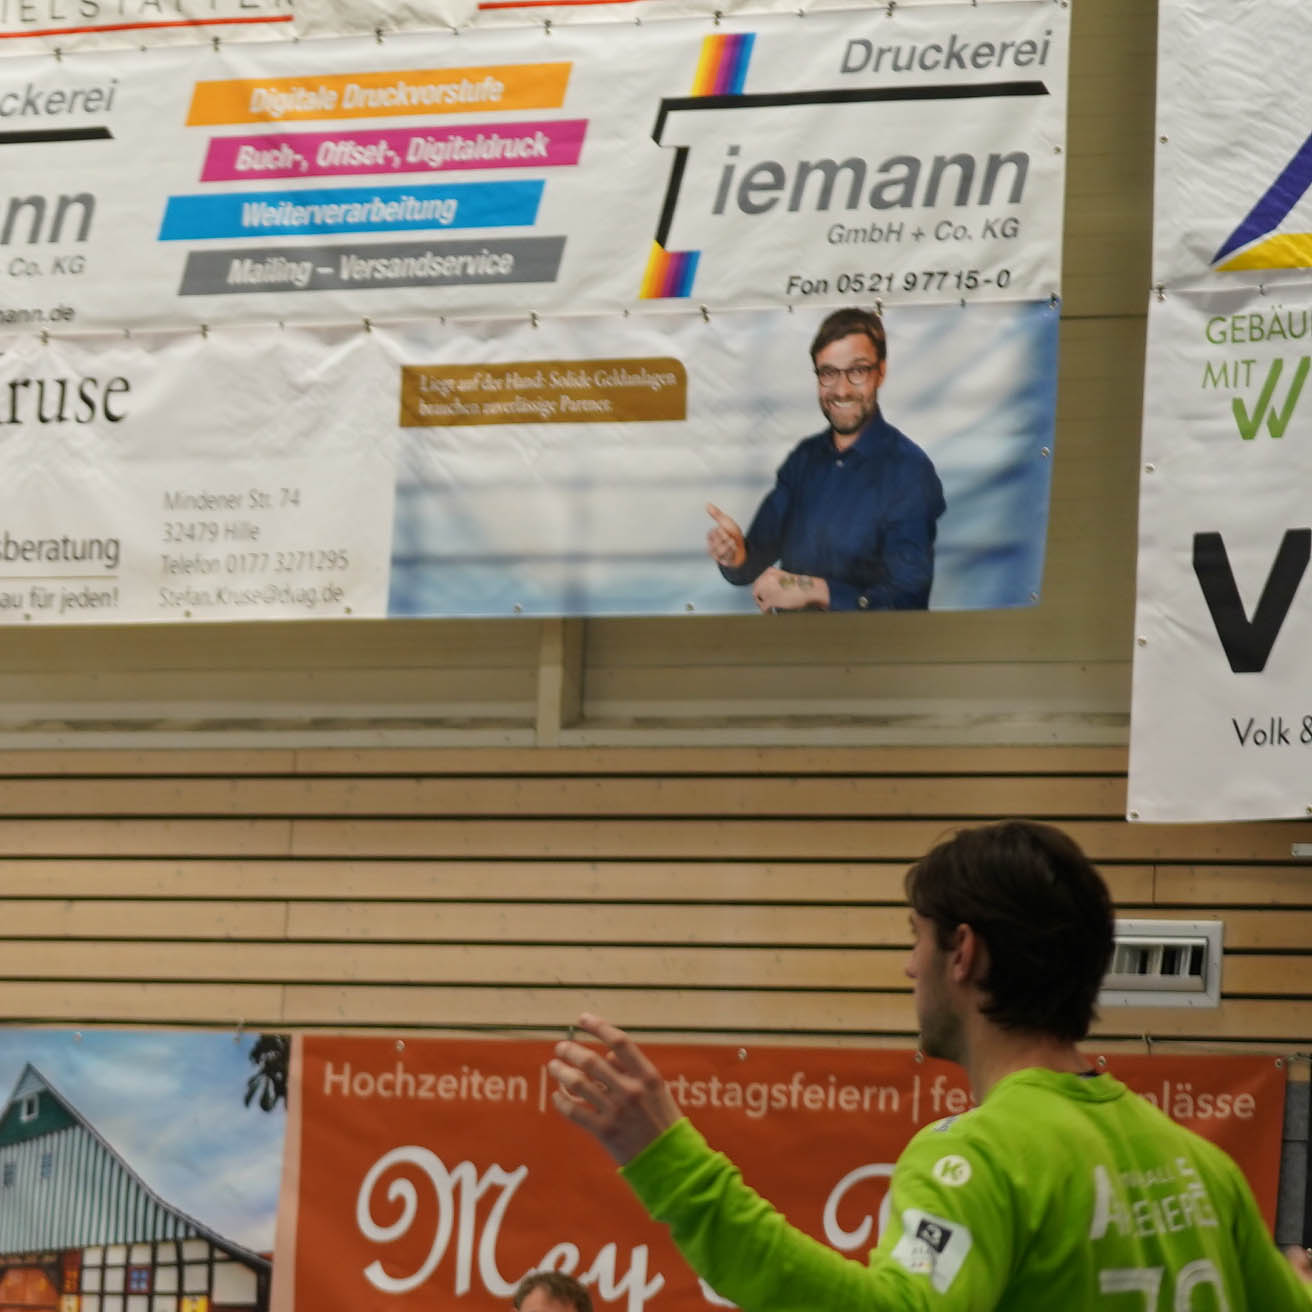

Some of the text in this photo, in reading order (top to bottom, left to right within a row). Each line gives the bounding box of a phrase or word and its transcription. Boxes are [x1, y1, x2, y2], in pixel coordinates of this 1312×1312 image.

[840, 30, 1052, 75] Druckerei
[249, 77, 505, 118] Digitale Druckvorstufe
[405, 132, 550, 167] Digitaldruck
[240, 197, 459, 228] Weiterverarbeitung
[826, 222, 905, 246] GmbH
[934, 221, 973, 243] Co.
[982, 218, 1021, 241] KG
[52, 255, 87, 275] KG
[227, 250, 515, 288] Mailing Versandservice
[786, 276, 828, 296] Fon
[836, 272, 894, 294] 0521
[1206, 304, 1312, 344] GEBÄU
[1202, 360, 1256, 389] MIT
[27, 585, 55, 609] für
[59, 584, 120, 614] jeden!
[1232, 716, 1291, 747] Volk
[323, 1061, 528, 1101] Hochzeiten
